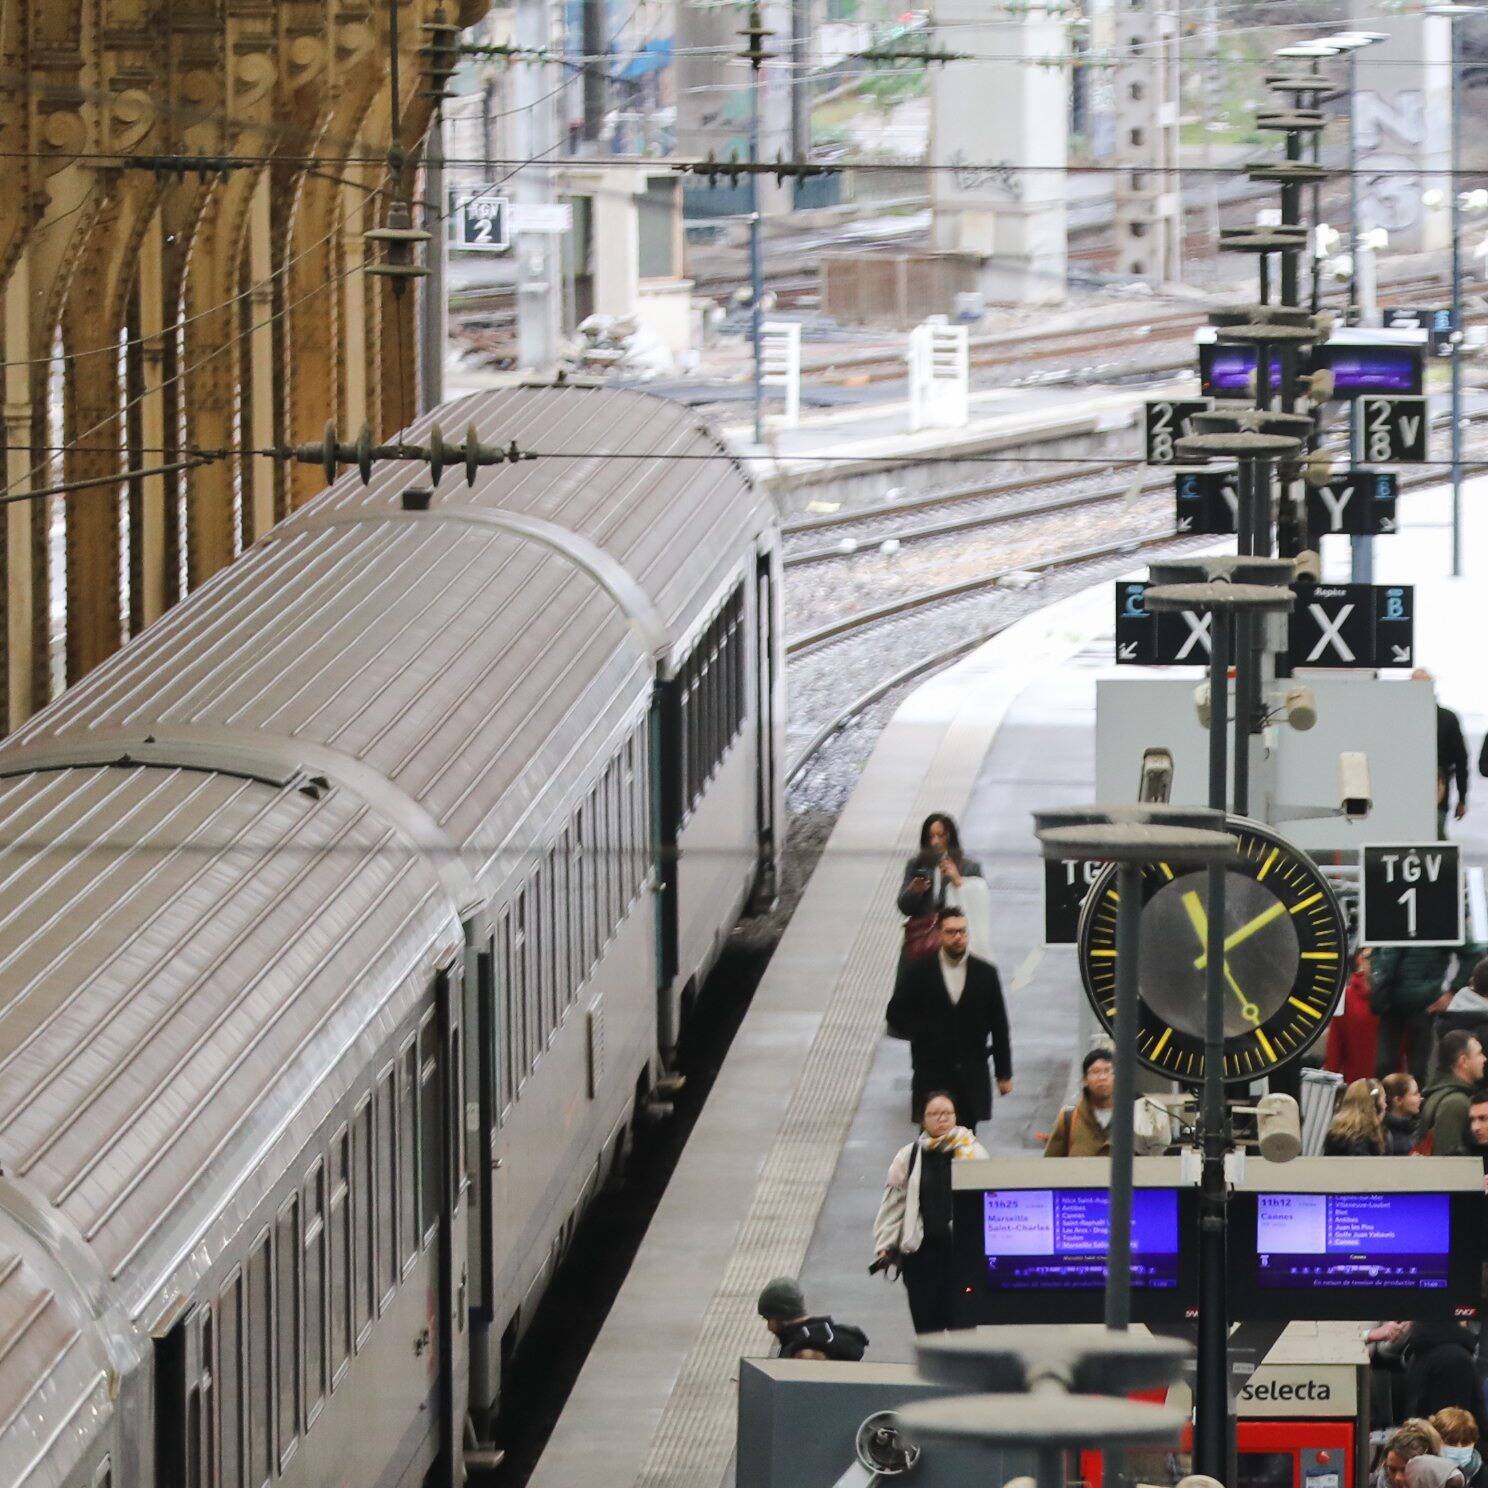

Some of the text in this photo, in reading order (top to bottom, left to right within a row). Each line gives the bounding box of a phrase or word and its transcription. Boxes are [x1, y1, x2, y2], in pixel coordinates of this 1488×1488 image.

[473, 219, 493, 243] 2
[1150, 401, 1173, 431] 2
[1369, 401, 1391, 431] 2
[1398, 414, 1420, 447] V
[1369, 430, 1391, 461] 8
[1319, 486, 1354, 532] Y
[1387, 597, 1404, 617] B
[1305, 603, 1356, 662] X
[1381, 851, 1442, 883] TGV
[1397, 888, 1417, 934] 1
[1241, 1380, 1331, 1401] selecta
